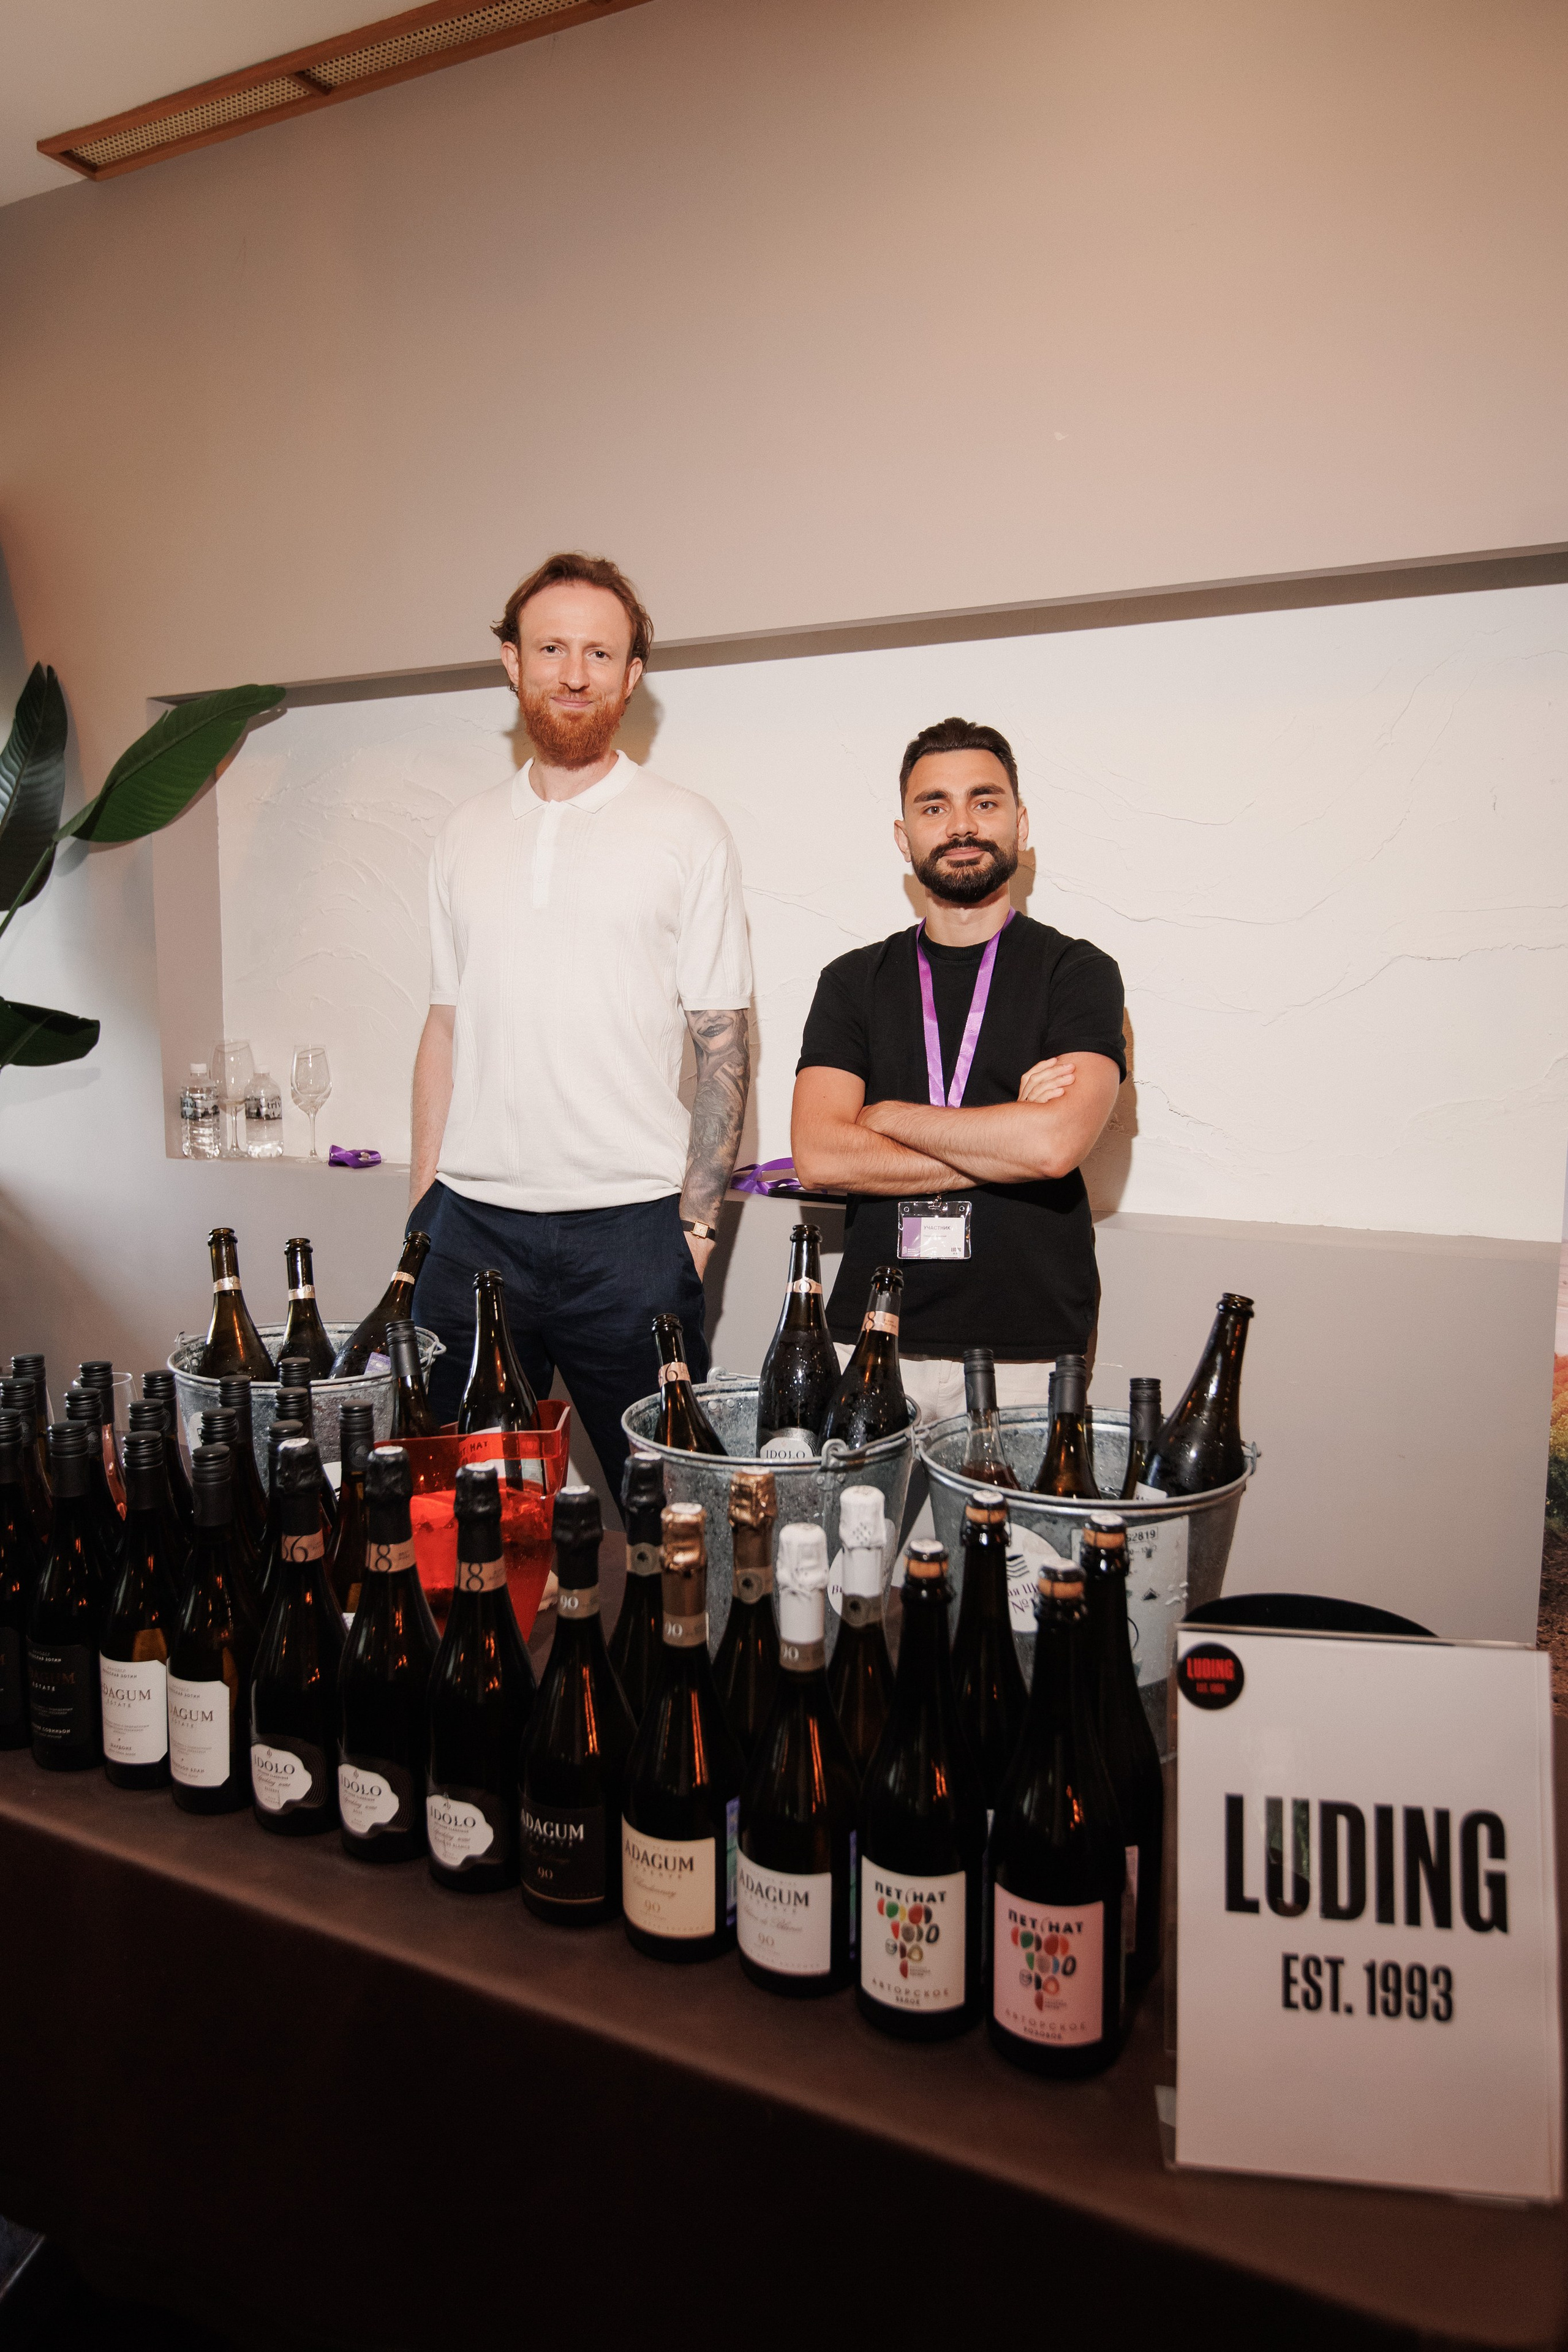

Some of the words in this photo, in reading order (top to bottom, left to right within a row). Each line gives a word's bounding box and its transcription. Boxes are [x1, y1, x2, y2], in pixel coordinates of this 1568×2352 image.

[254, 1754, 295, 1774] IDOLO
[341, 1774, 382, 1796] IDOLO
[431, 1805, 476, 1828] IDOLO
[521, 1808, 584, 1841] ADAGUM
[625, 1838, 694, 1872] ADAGUM
[1224, 1792, 1509, 1936] LUDING
[537, 1866, 553, 1879] 90
[739, 1868, 809, 1907] ADAGUM
[875, 1880, 902, 1901] ПЕТ
[913, 1890, 946, 1904] НАТ
[645, 1899, 661, 1912] 90
[1008, 1909, 1037, 1929] ПЕТ
[1048, 1921, 1084, 1934] НАТ
[758, 1932, 774, 1946] 90
[872, 1977, 949, 1997] АВТОРСКОЕ
[1281, 1951, 1354, 2015] EST.
[1363, 1959, 1454, 2022] 1993
[1005, 2008, 1085, 2031] АВТОРСКОЕ
